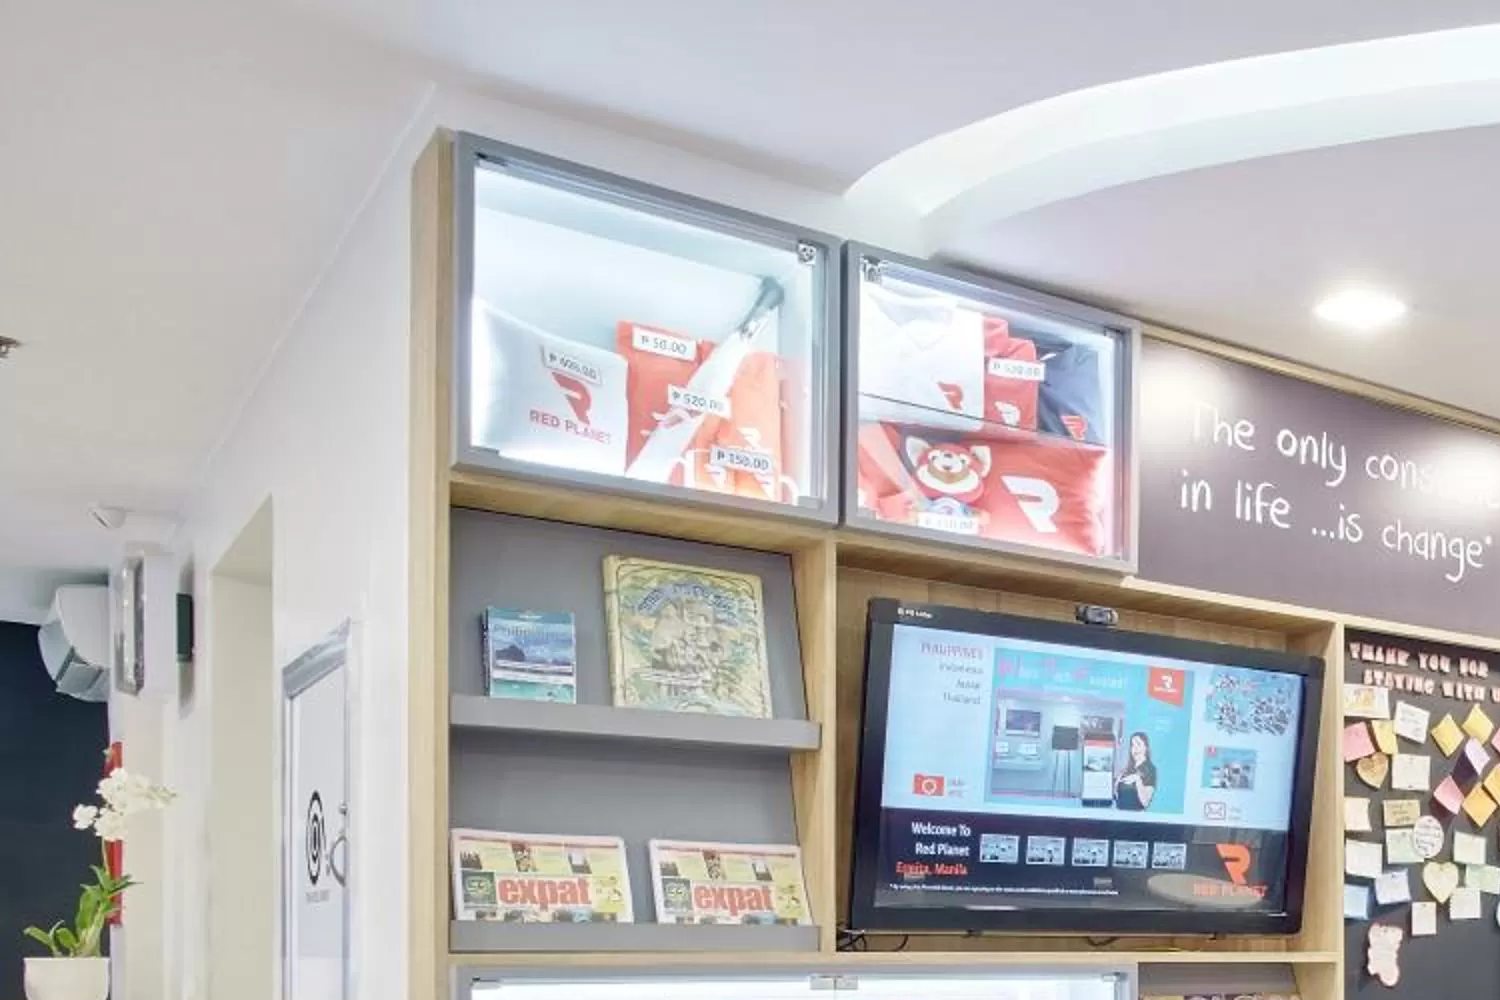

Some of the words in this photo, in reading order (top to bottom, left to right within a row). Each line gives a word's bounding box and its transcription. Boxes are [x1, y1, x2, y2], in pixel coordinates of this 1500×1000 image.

[528, 408, 561, 429] RED
[565, 419, 612, 445] PLANET
[1192, 400, 1256, 451] The
[1276, 428, 1348, 488] only
[1365, 451, 1500, 508] cons
[1179, 469, 1213, 513] in
[1234, 480, 1292, 529] life
[1310, 503, 1364, 543] ...is
[1350, 642, 1411, 667] THANK
[1418, 652, 1451, 673] YOU
[1459, 657, 1489, 679] FOR
[1363, 668, 1435, 695] STAYING
[1441, 680, 1485, 701] WITH
[911, 821, 957, 836] Welcome
[959, 824, 971, 837] To
[915, 842, 936, 856] Red
[938, 844, 970, 857] Planet
[936, 862, 968, 876] Manila
[498, 876, 592, 912] expat
[694, 884, 774, 917] expat
